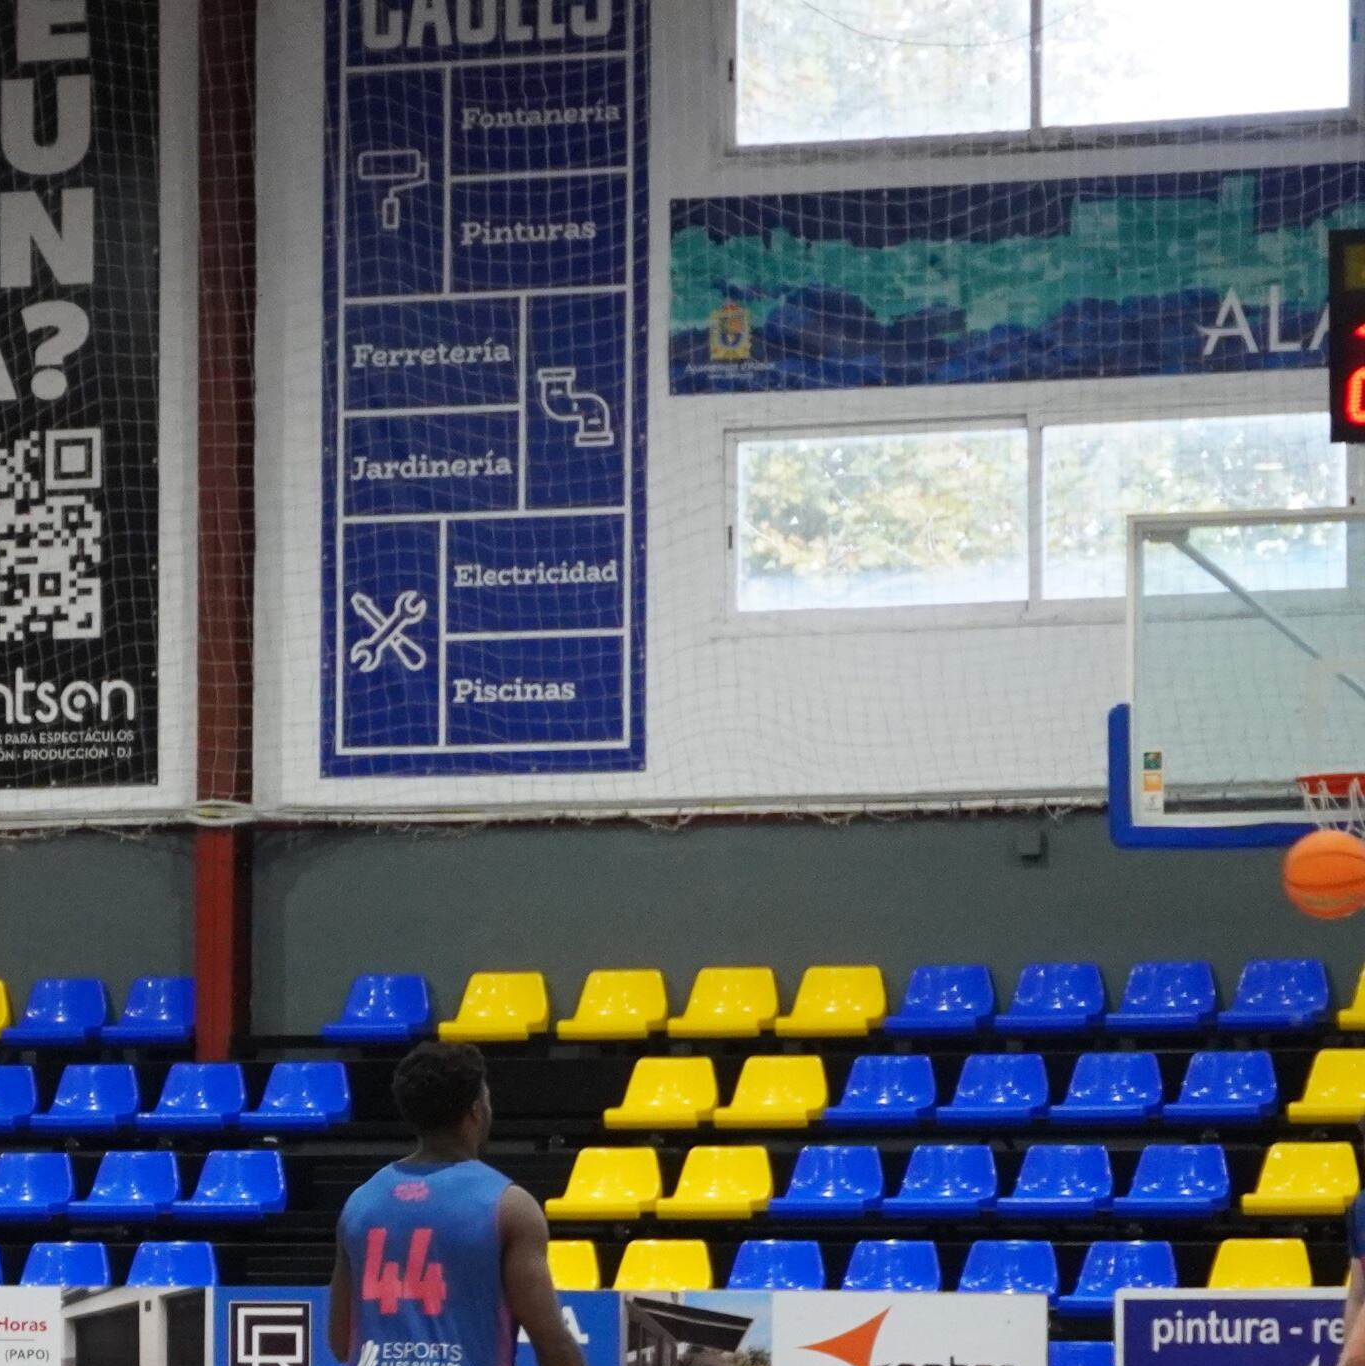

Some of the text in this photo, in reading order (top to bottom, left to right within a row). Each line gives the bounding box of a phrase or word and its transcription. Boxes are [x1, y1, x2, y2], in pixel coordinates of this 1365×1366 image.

[461, 100, 621, 129] Fontanería
[460, 220, 597, 246] Pinturas
[351, 338, 512, 368] Ferretería
[350, 450, 513, 480] Jardinería
[453, 560, 619, 587] Electricidad
[452, 678, 576, 703] Piscinas
[4, 732, 36, 746] PARA
[39, 727, 134, 744] ESPECTÁCULOS
[23, 745, 109, 761] PRODUCCIÓN
[362, 1228, 448, 1316] 44
[1152, 1310, 1281, 1352] pintura
[5, 1349, 50, 1362] (PAPO)
[381, 1341, 463, 1361] ESPORTS
